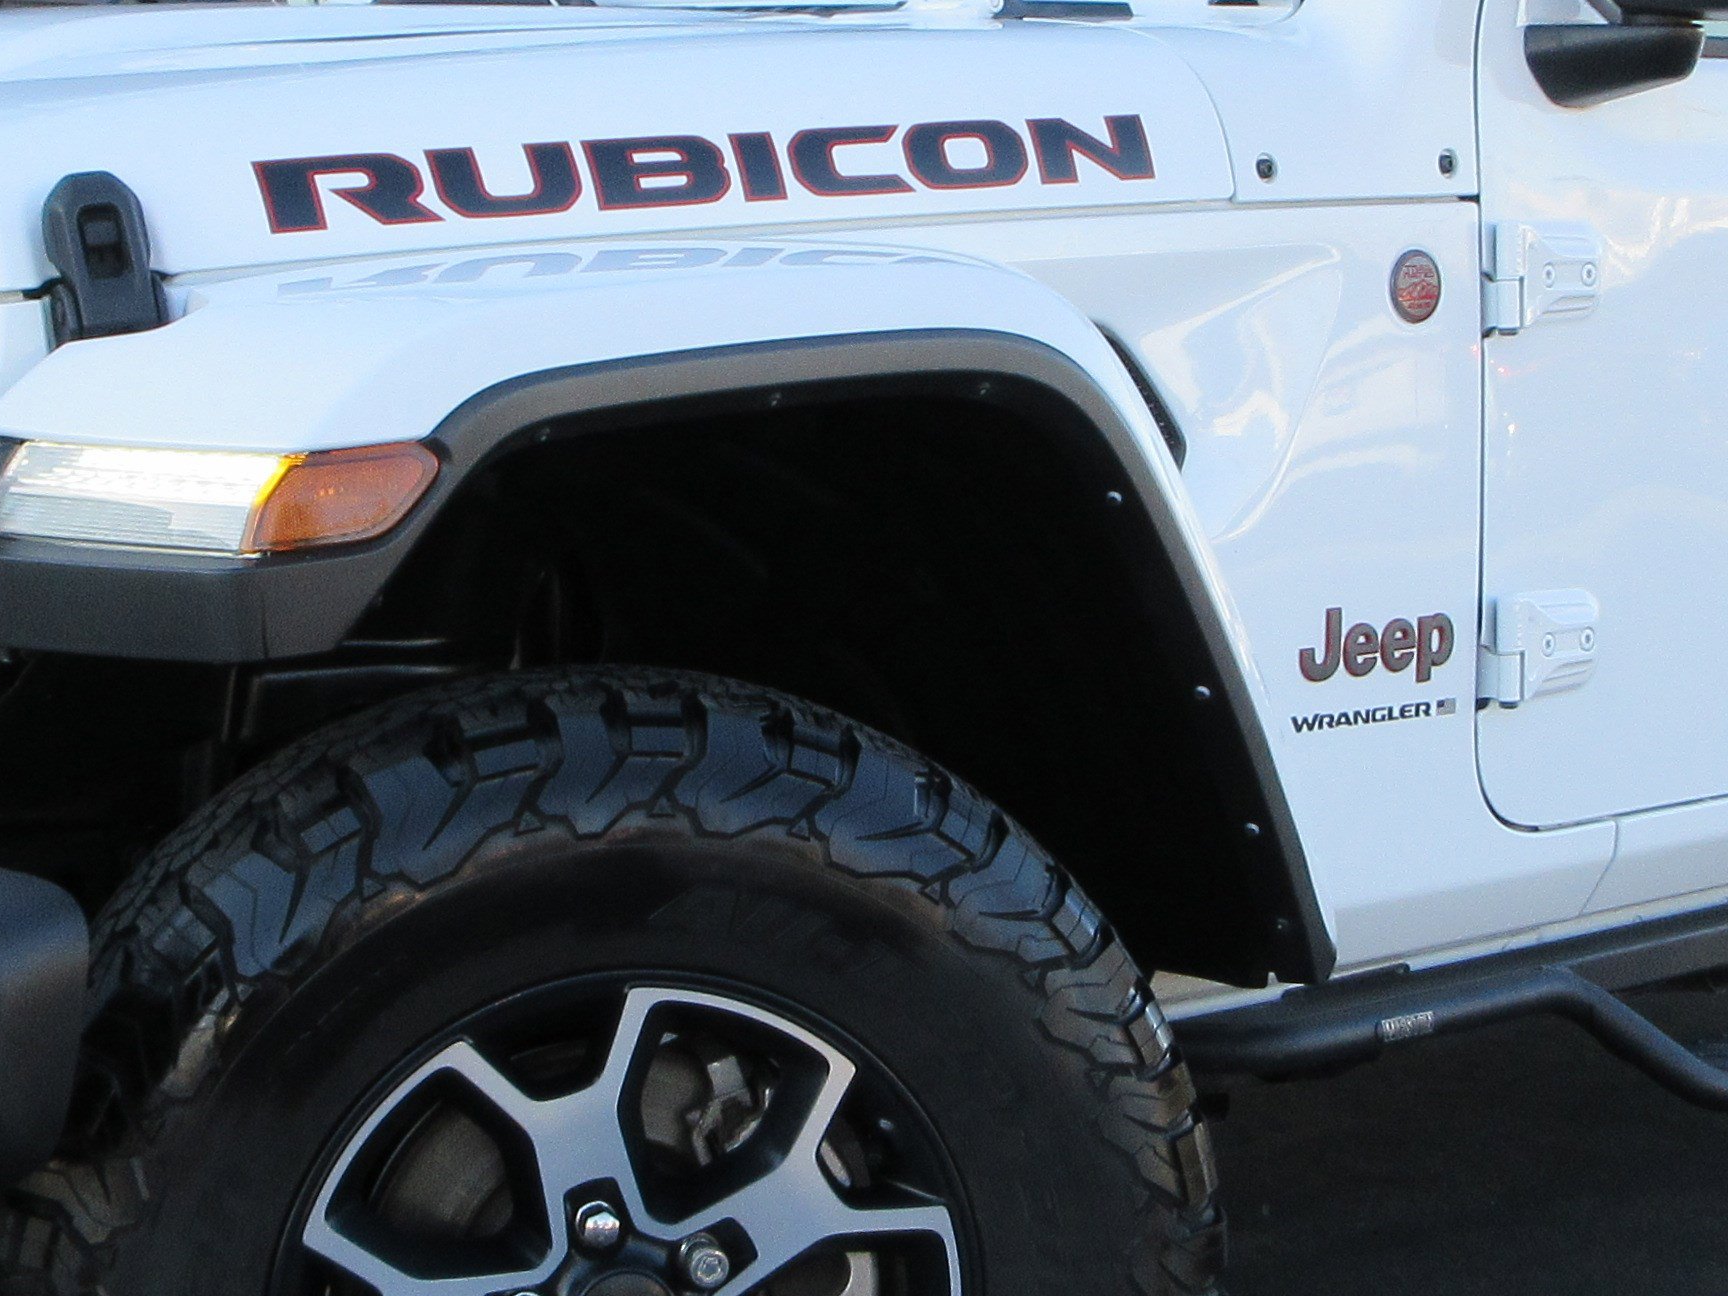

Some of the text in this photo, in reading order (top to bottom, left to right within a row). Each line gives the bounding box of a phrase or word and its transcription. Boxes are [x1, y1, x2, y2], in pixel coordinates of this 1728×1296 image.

[250, 113, 1156, 234] RUBICON
[1297, 606, 1455, 683] Jeep
[1290, 699, 1432, 735] WRANGLER
